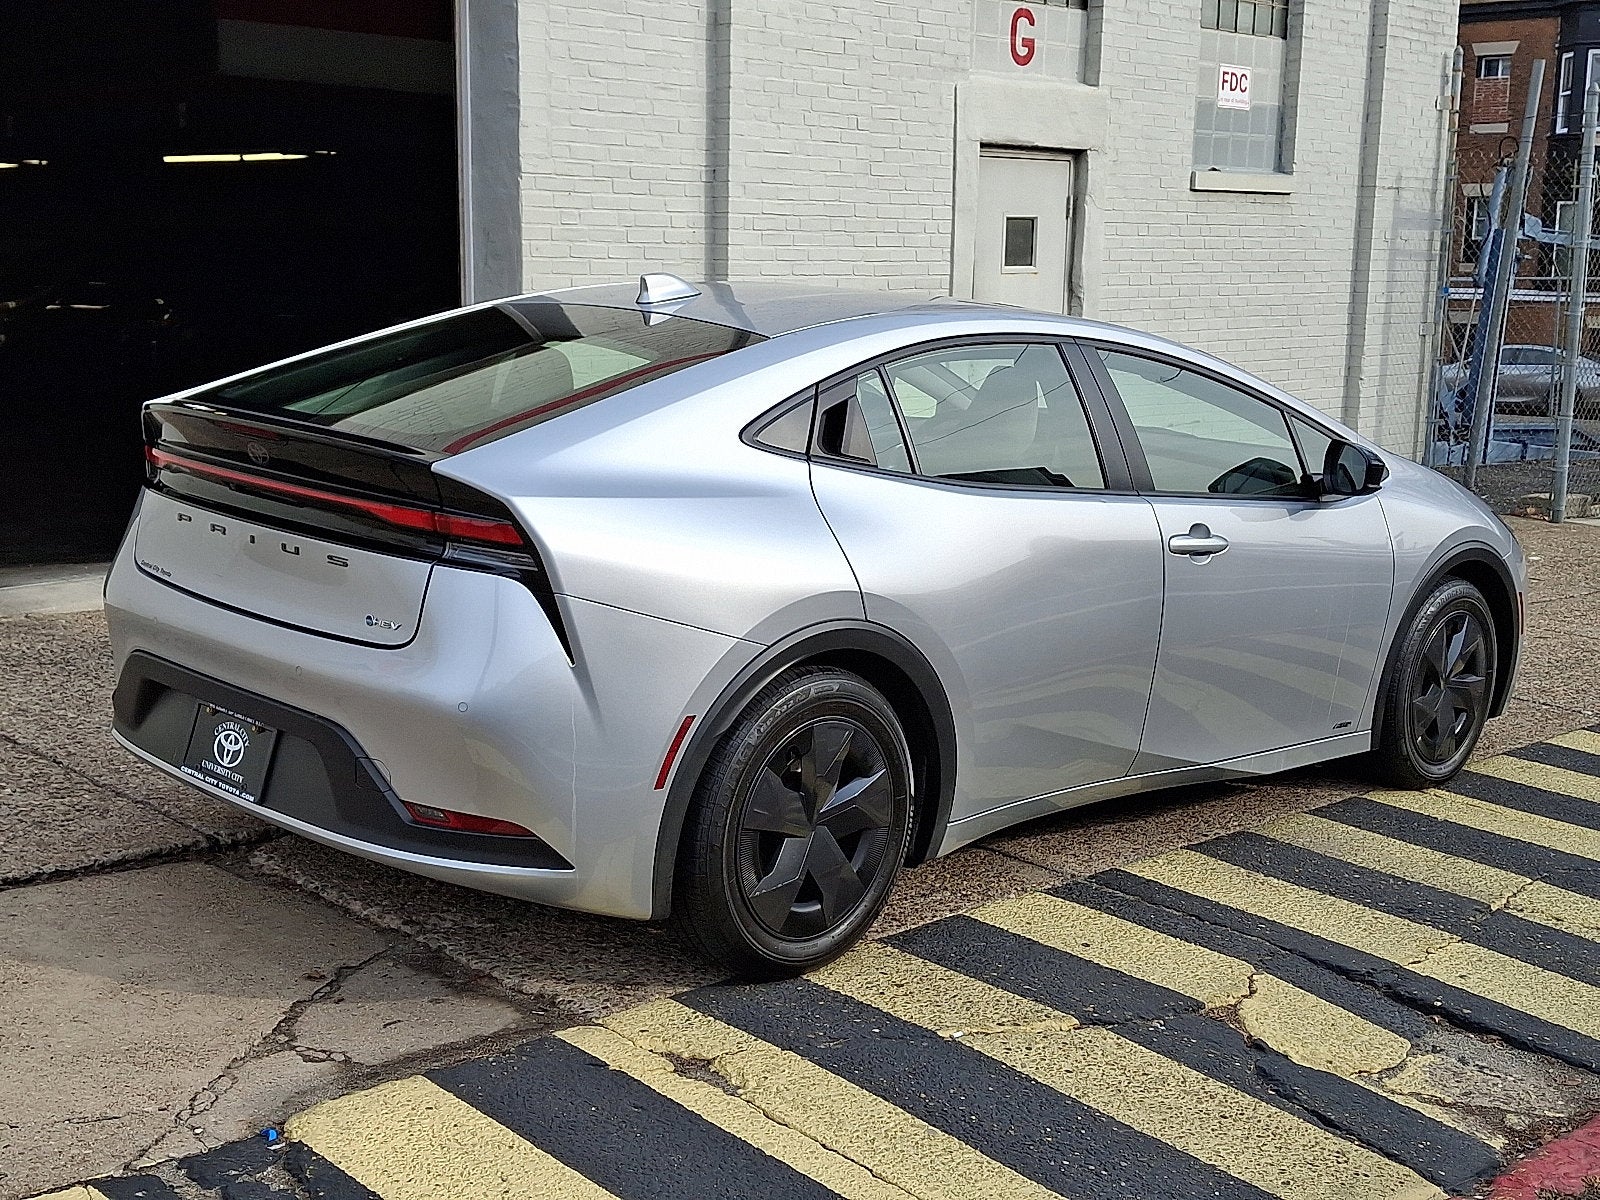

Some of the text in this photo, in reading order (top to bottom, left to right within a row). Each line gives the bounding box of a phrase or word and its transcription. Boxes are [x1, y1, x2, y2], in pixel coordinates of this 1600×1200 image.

[1010, 8, 1035, 66] G
[1221, 71, 1248, 94] FDC
[177, 512, 350, 568] PRIUS
[214, 721, 250, 748] CENTRAL CITY
[180, 765, 205, 780] CENTRAL
[205, 776, 218, 786] CITY
[201, 759, 245, 784] UNIVERSITY CITY
